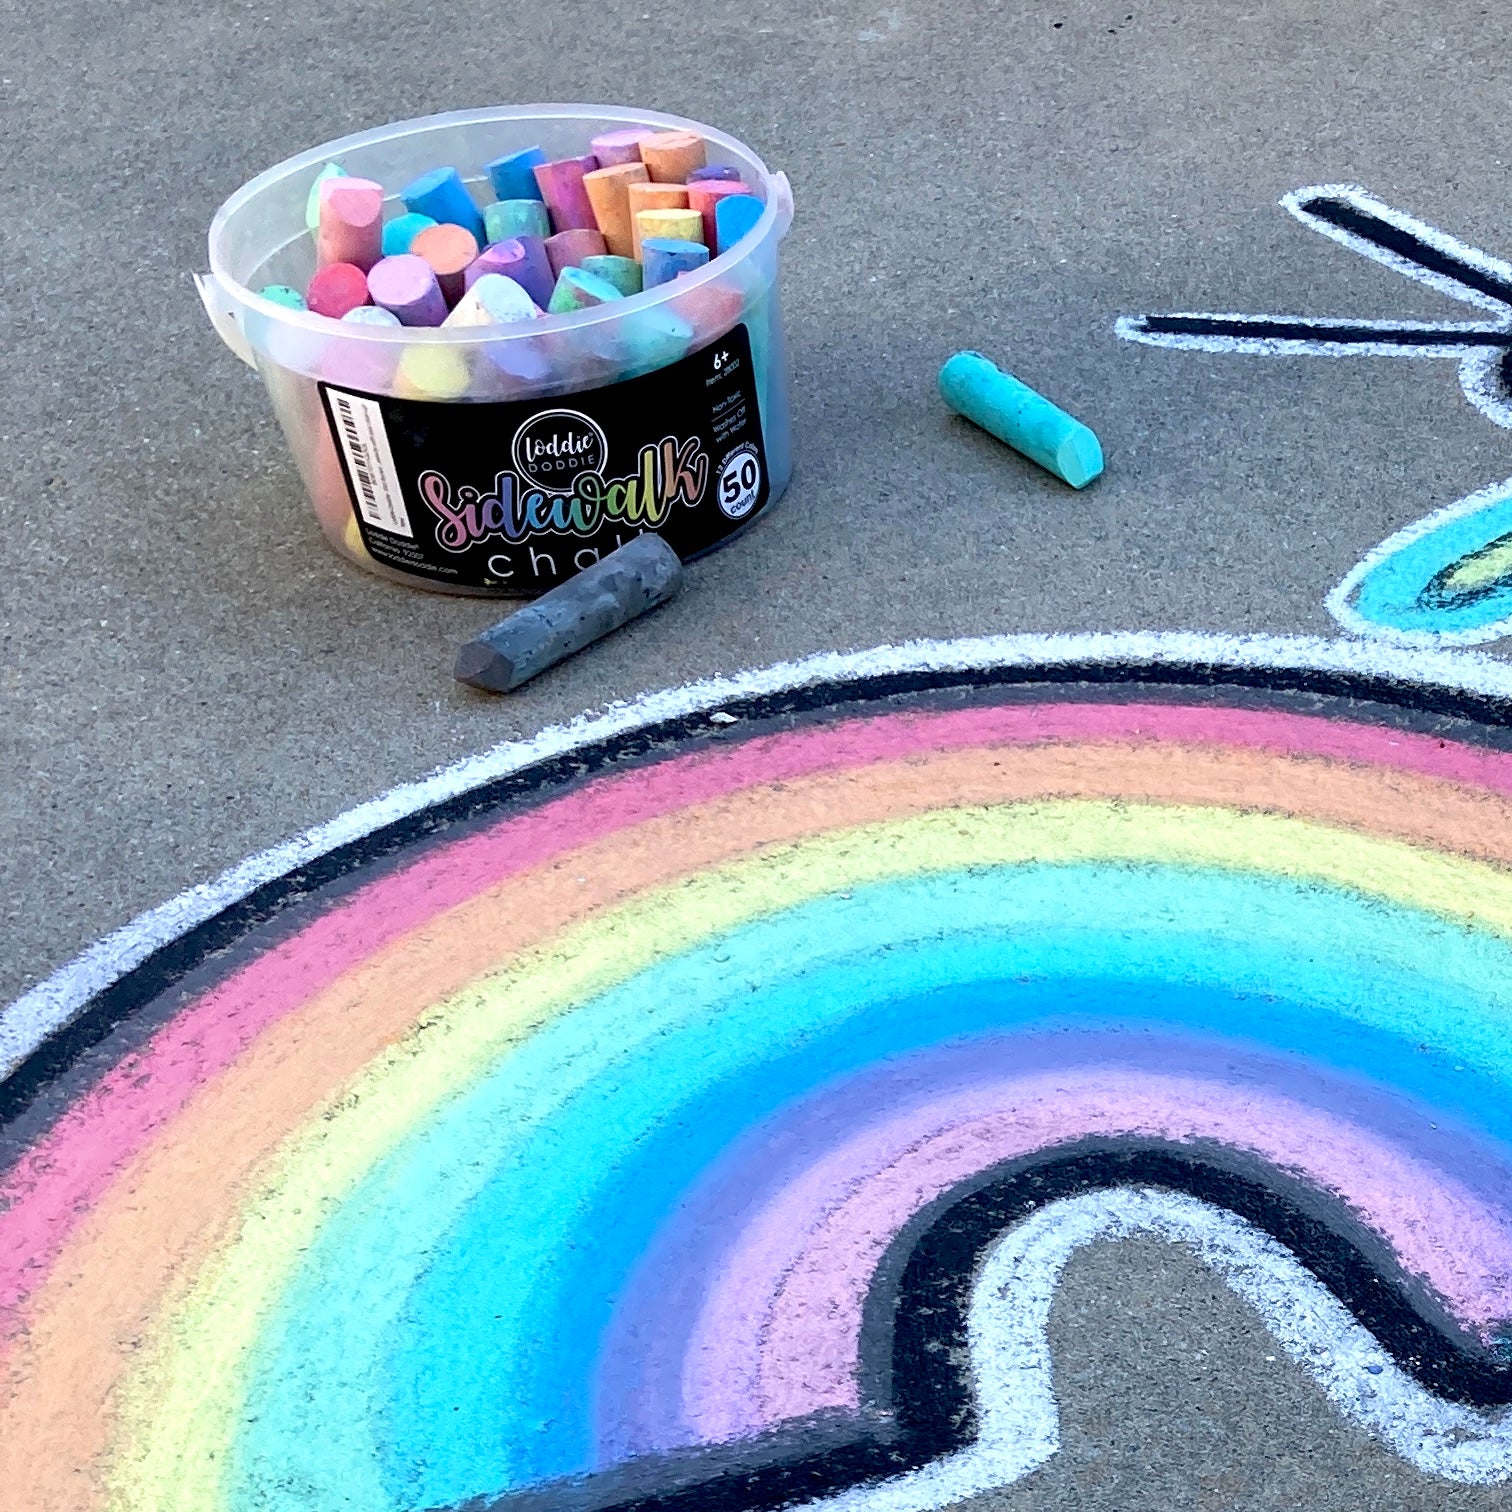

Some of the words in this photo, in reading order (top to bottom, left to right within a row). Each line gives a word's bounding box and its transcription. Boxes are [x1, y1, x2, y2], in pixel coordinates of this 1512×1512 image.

[714, 351, 729, 369] 6+
[528, 454, 595, 473] DODDIE
[422, 441, 706, 548] Sidewalk
[722, 459, 757, 503] 50
[730, 489, 756, 514] count
[488, 529, 645, 577] cha
